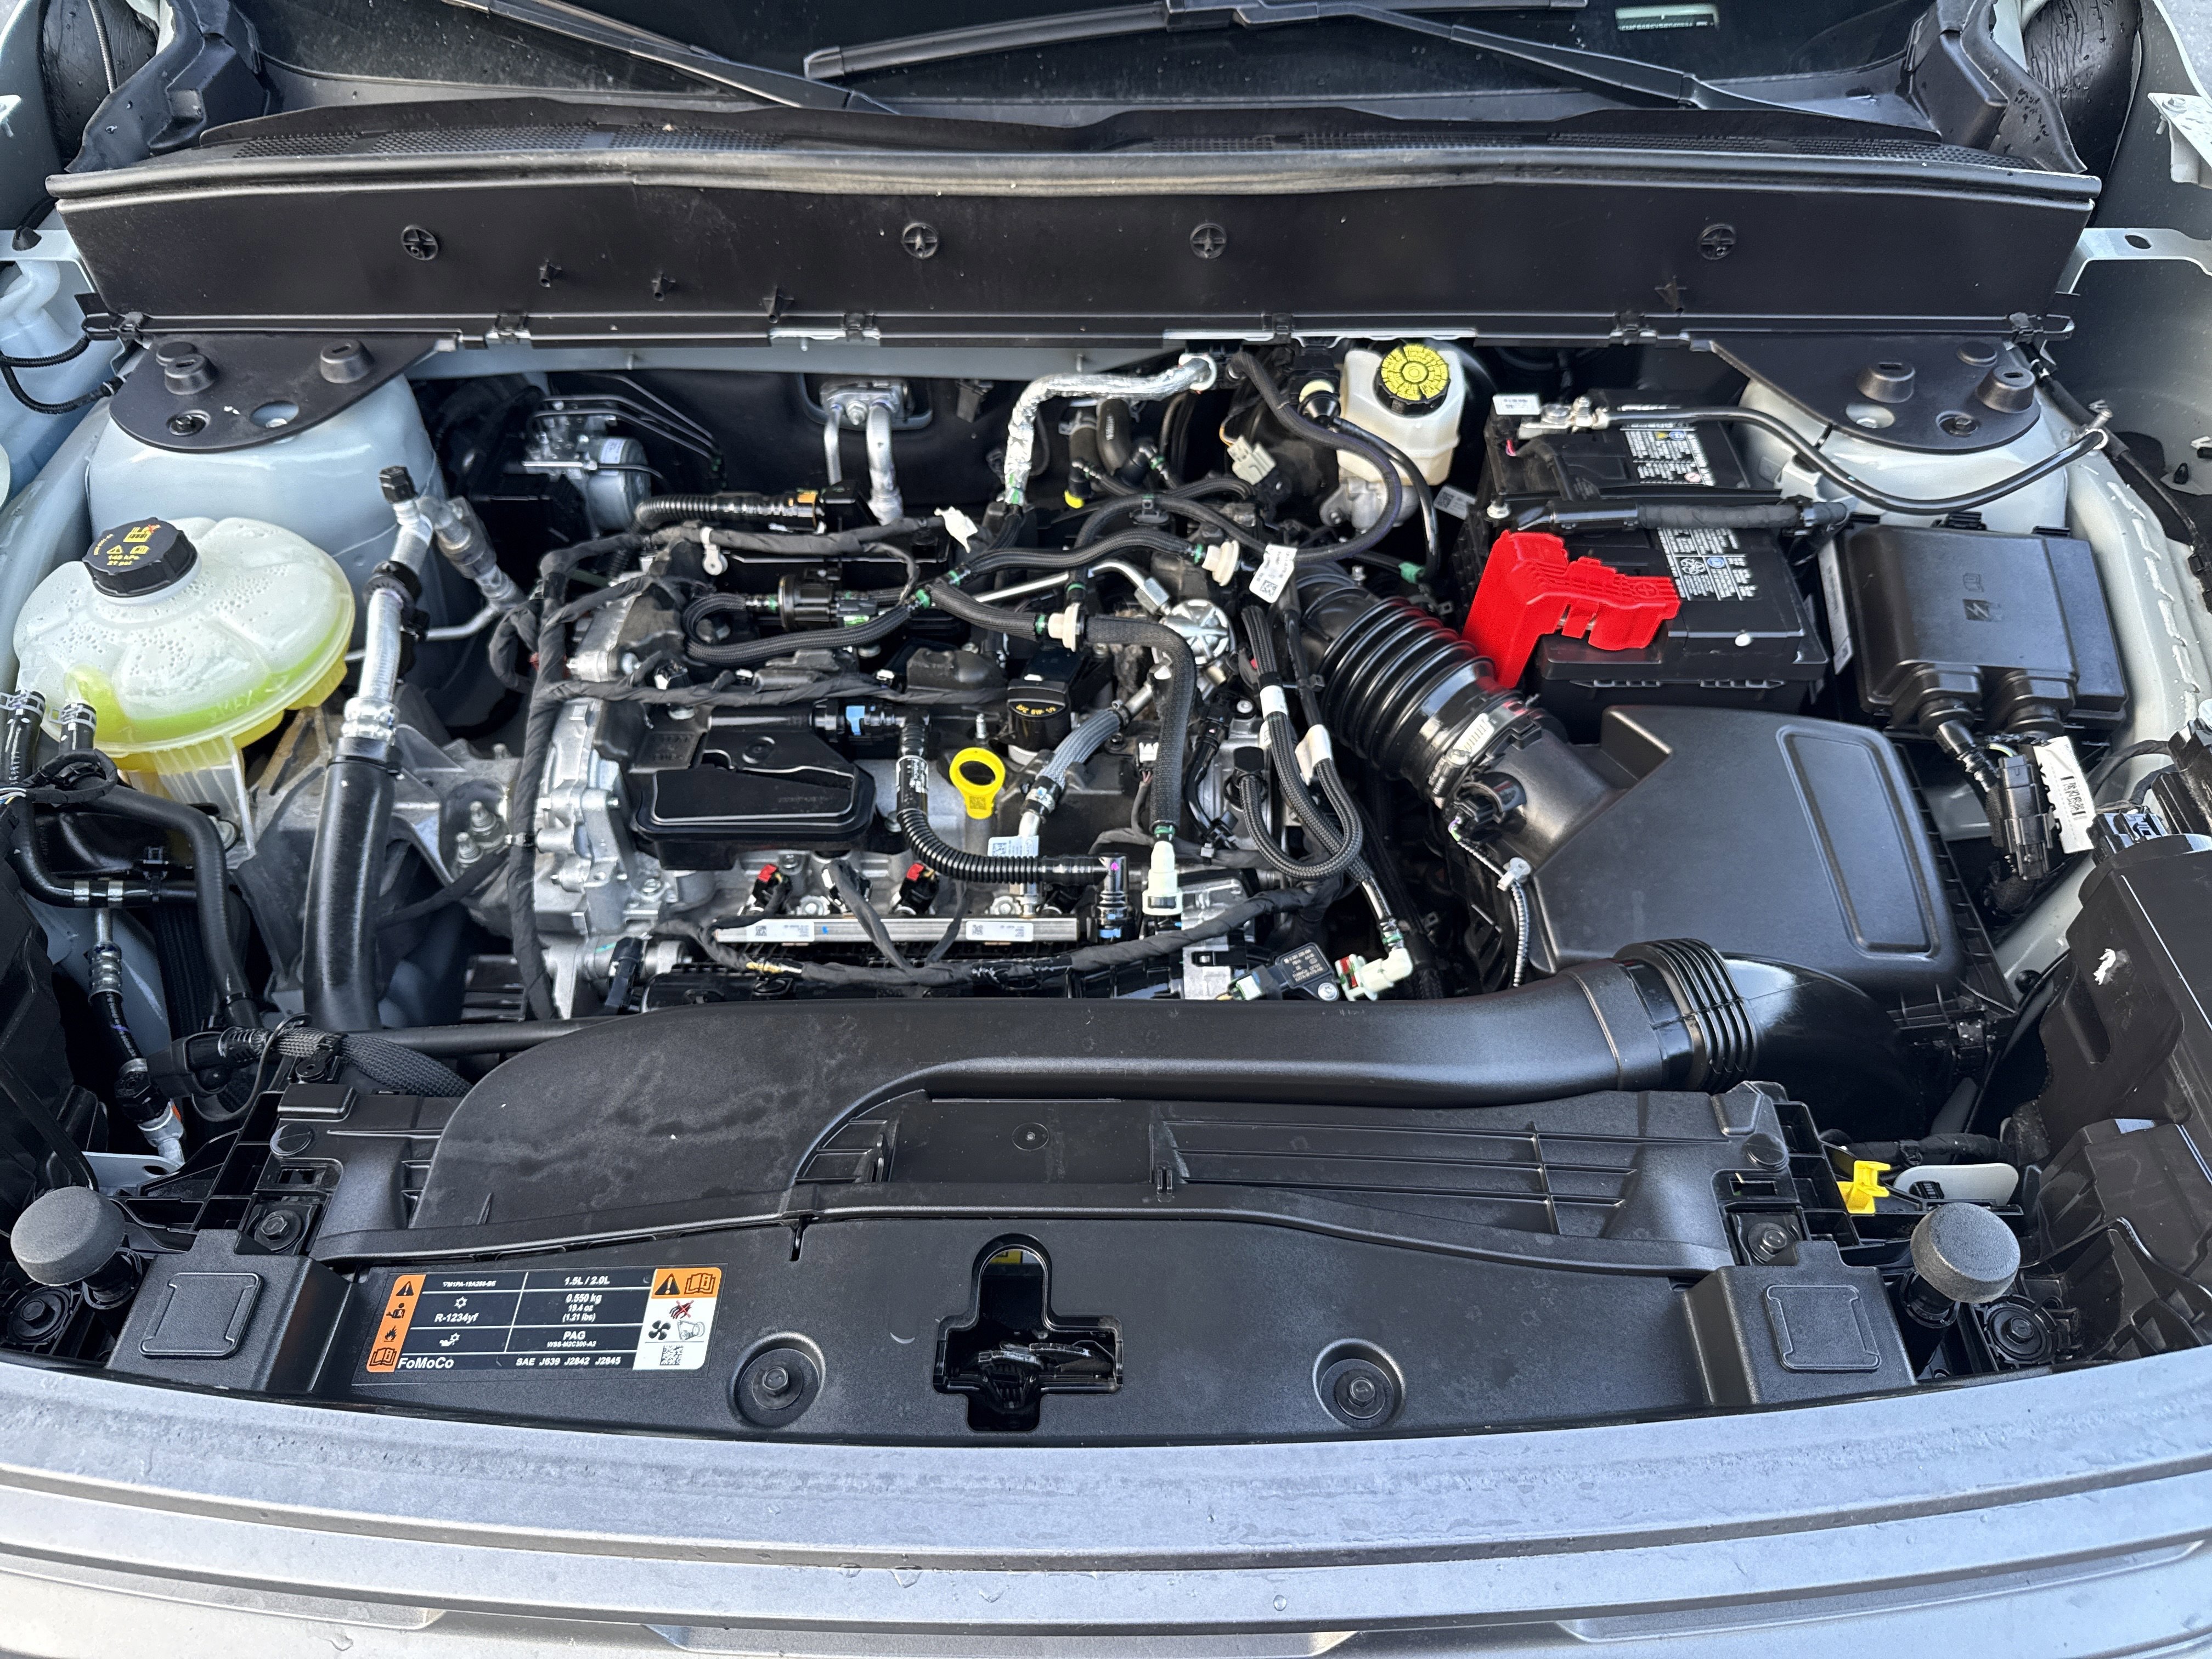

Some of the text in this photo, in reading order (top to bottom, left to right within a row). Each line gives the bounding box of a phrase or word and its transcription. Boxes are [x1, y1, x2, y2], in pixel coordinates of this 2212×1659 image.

[564, 1276, 584, 1286] 1.5L
[589, 1276, 610, 1285] 2.0L
[565, 1293, 602, 1305] 0.550 kg
[567, 1304, 584, 1312] 19.4
[433, 1312, 479, 1324] R-1234yf
[561, 1312, 596, 1323] (1.21 lbs)
[562, 1330, 586, 1341] PAG
[397, 1356, 455, 1369] FoMoCo
[516, 1356, 622, 1366] SAE J639 J2842 J2845
